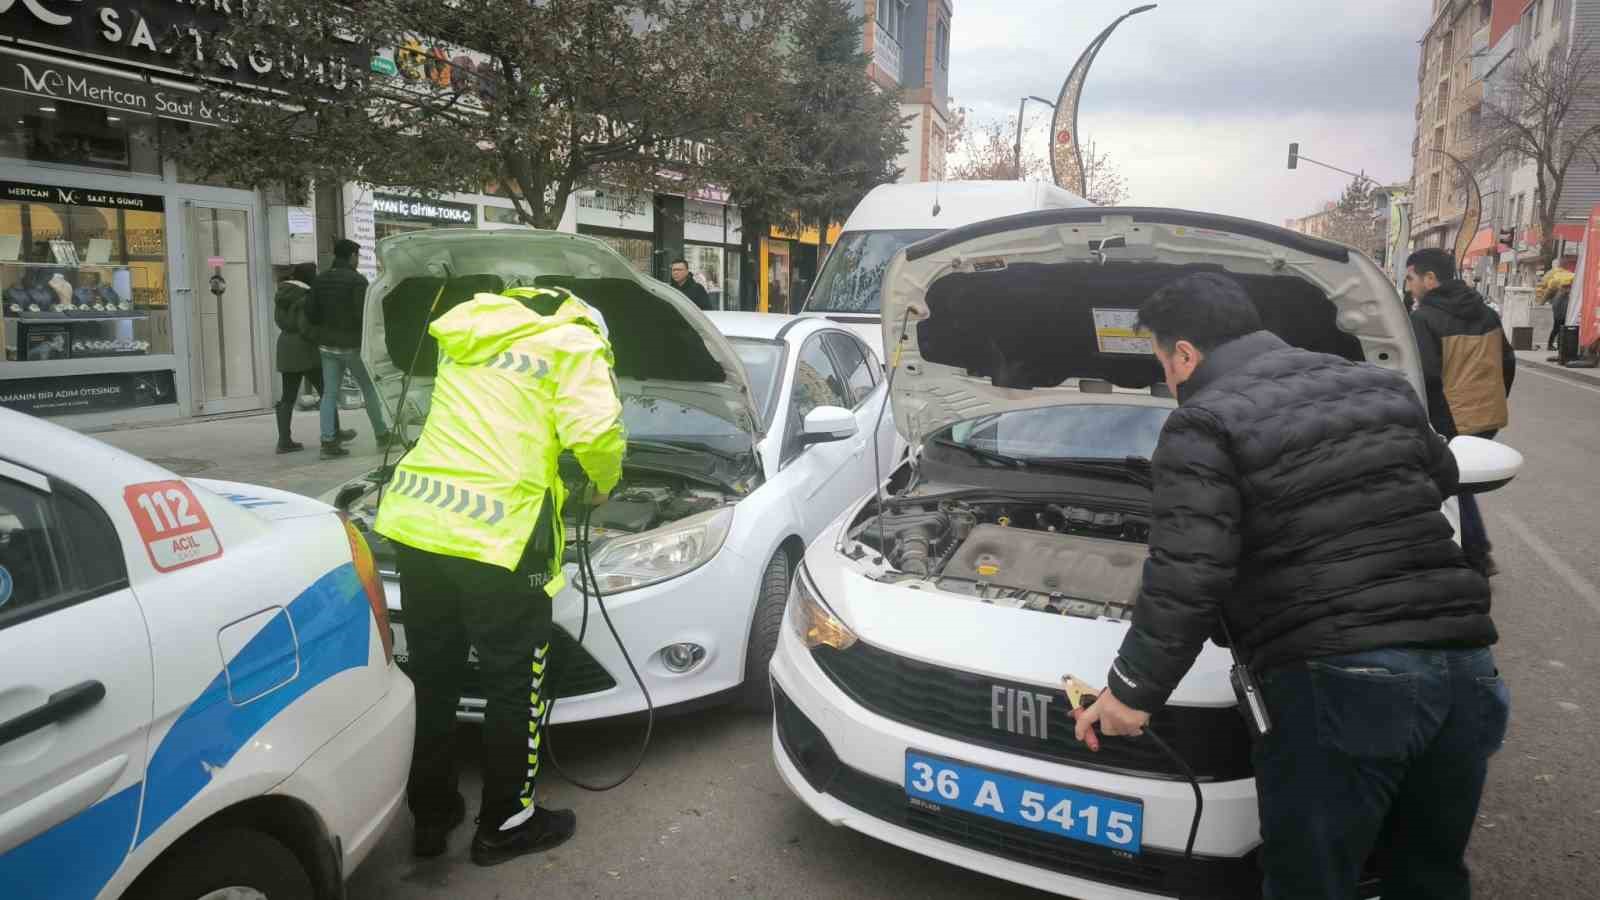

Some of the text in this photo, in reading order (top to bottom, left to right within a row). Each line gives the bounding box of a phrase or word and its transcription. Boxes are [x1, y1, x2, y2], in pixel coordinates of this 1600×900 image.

[67, 74, 147, 108] Mertcan
[200, 100, 213, 119] &
[7, 187, 49, 199] MERTCAN
[87, 194, 106, 203] SAAT
[108, 196, 115, 205] &
[138, 489, 200, 532] 112
[991, 684, 1053, 740] FIAT
[911, 762, 1133, 845] 36 A 5415
